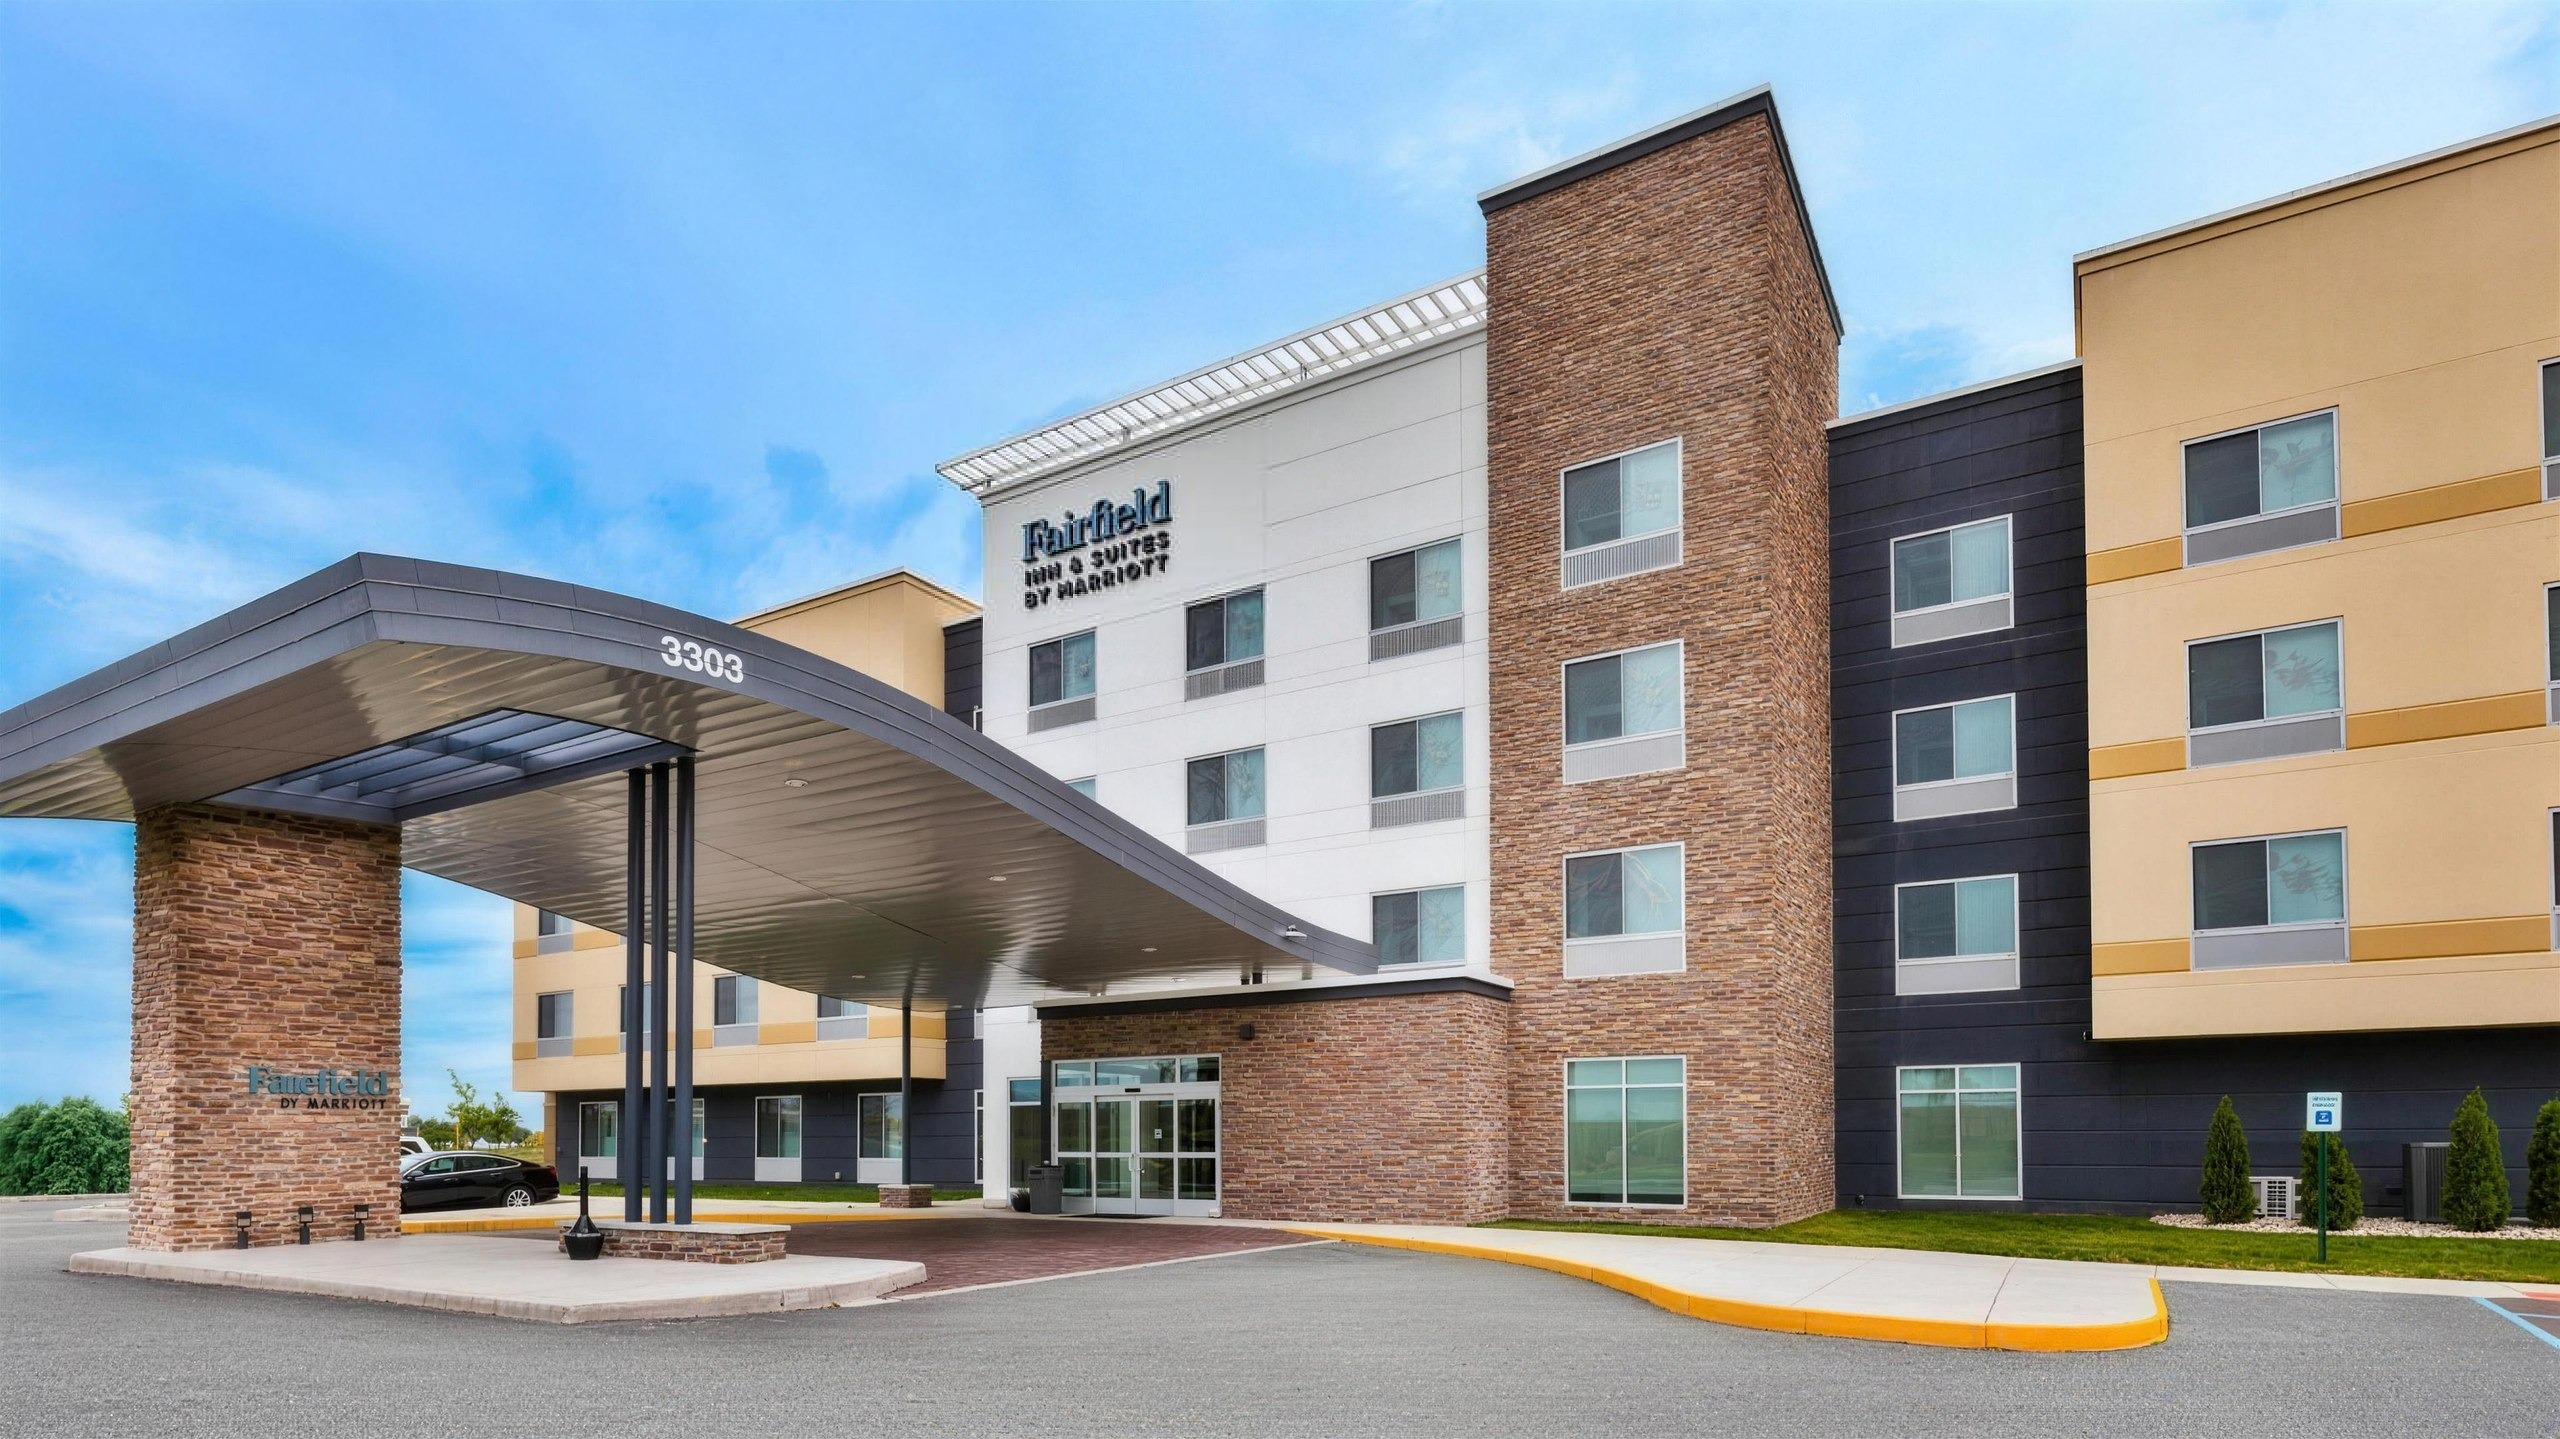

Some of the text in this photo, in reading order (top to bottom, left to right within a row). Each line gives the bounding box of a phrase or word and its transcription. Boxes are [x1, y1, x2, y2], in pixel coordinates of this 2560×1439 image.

[1022, 480, 1173, 563] Fairfield
[1024, 561, 1062, 587] INN
[1090, 530, 1171, 569] SUITES
[1024, 553, 1170, 610] BY MARRIOTT
[661, 635, 744, 683] 3303
[307, 1098, 387, 1110] MARRIOTT
